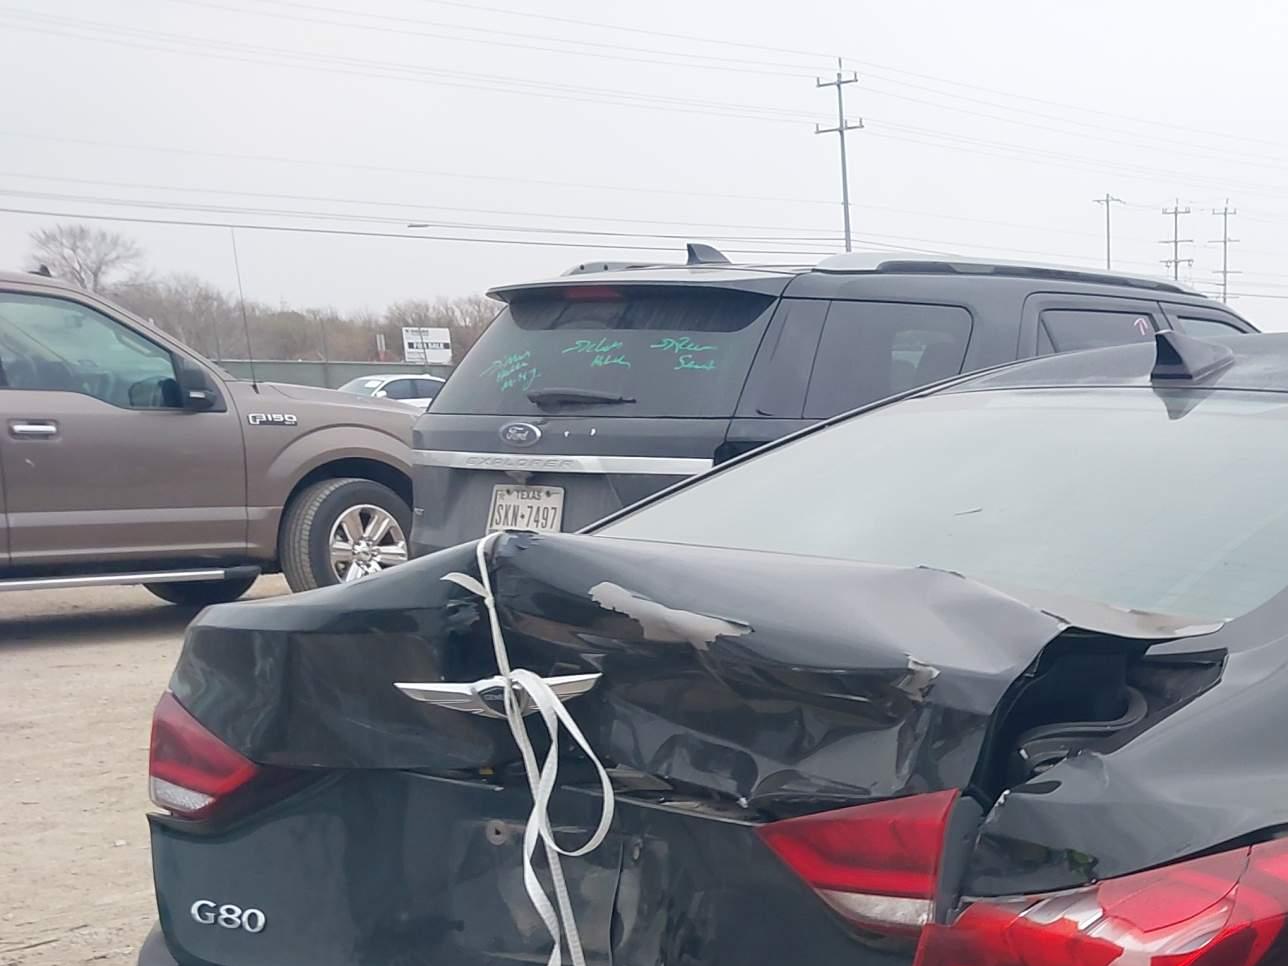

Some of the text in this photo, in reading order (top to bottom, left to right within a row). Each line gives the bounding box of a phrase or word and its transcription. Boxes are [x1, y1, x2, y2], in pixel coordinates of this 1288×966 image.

[465, 455, 577, 469] EXPLORER
[515, 489, 543, 501] TEXAS
[191, 899, 266, 933] G80
